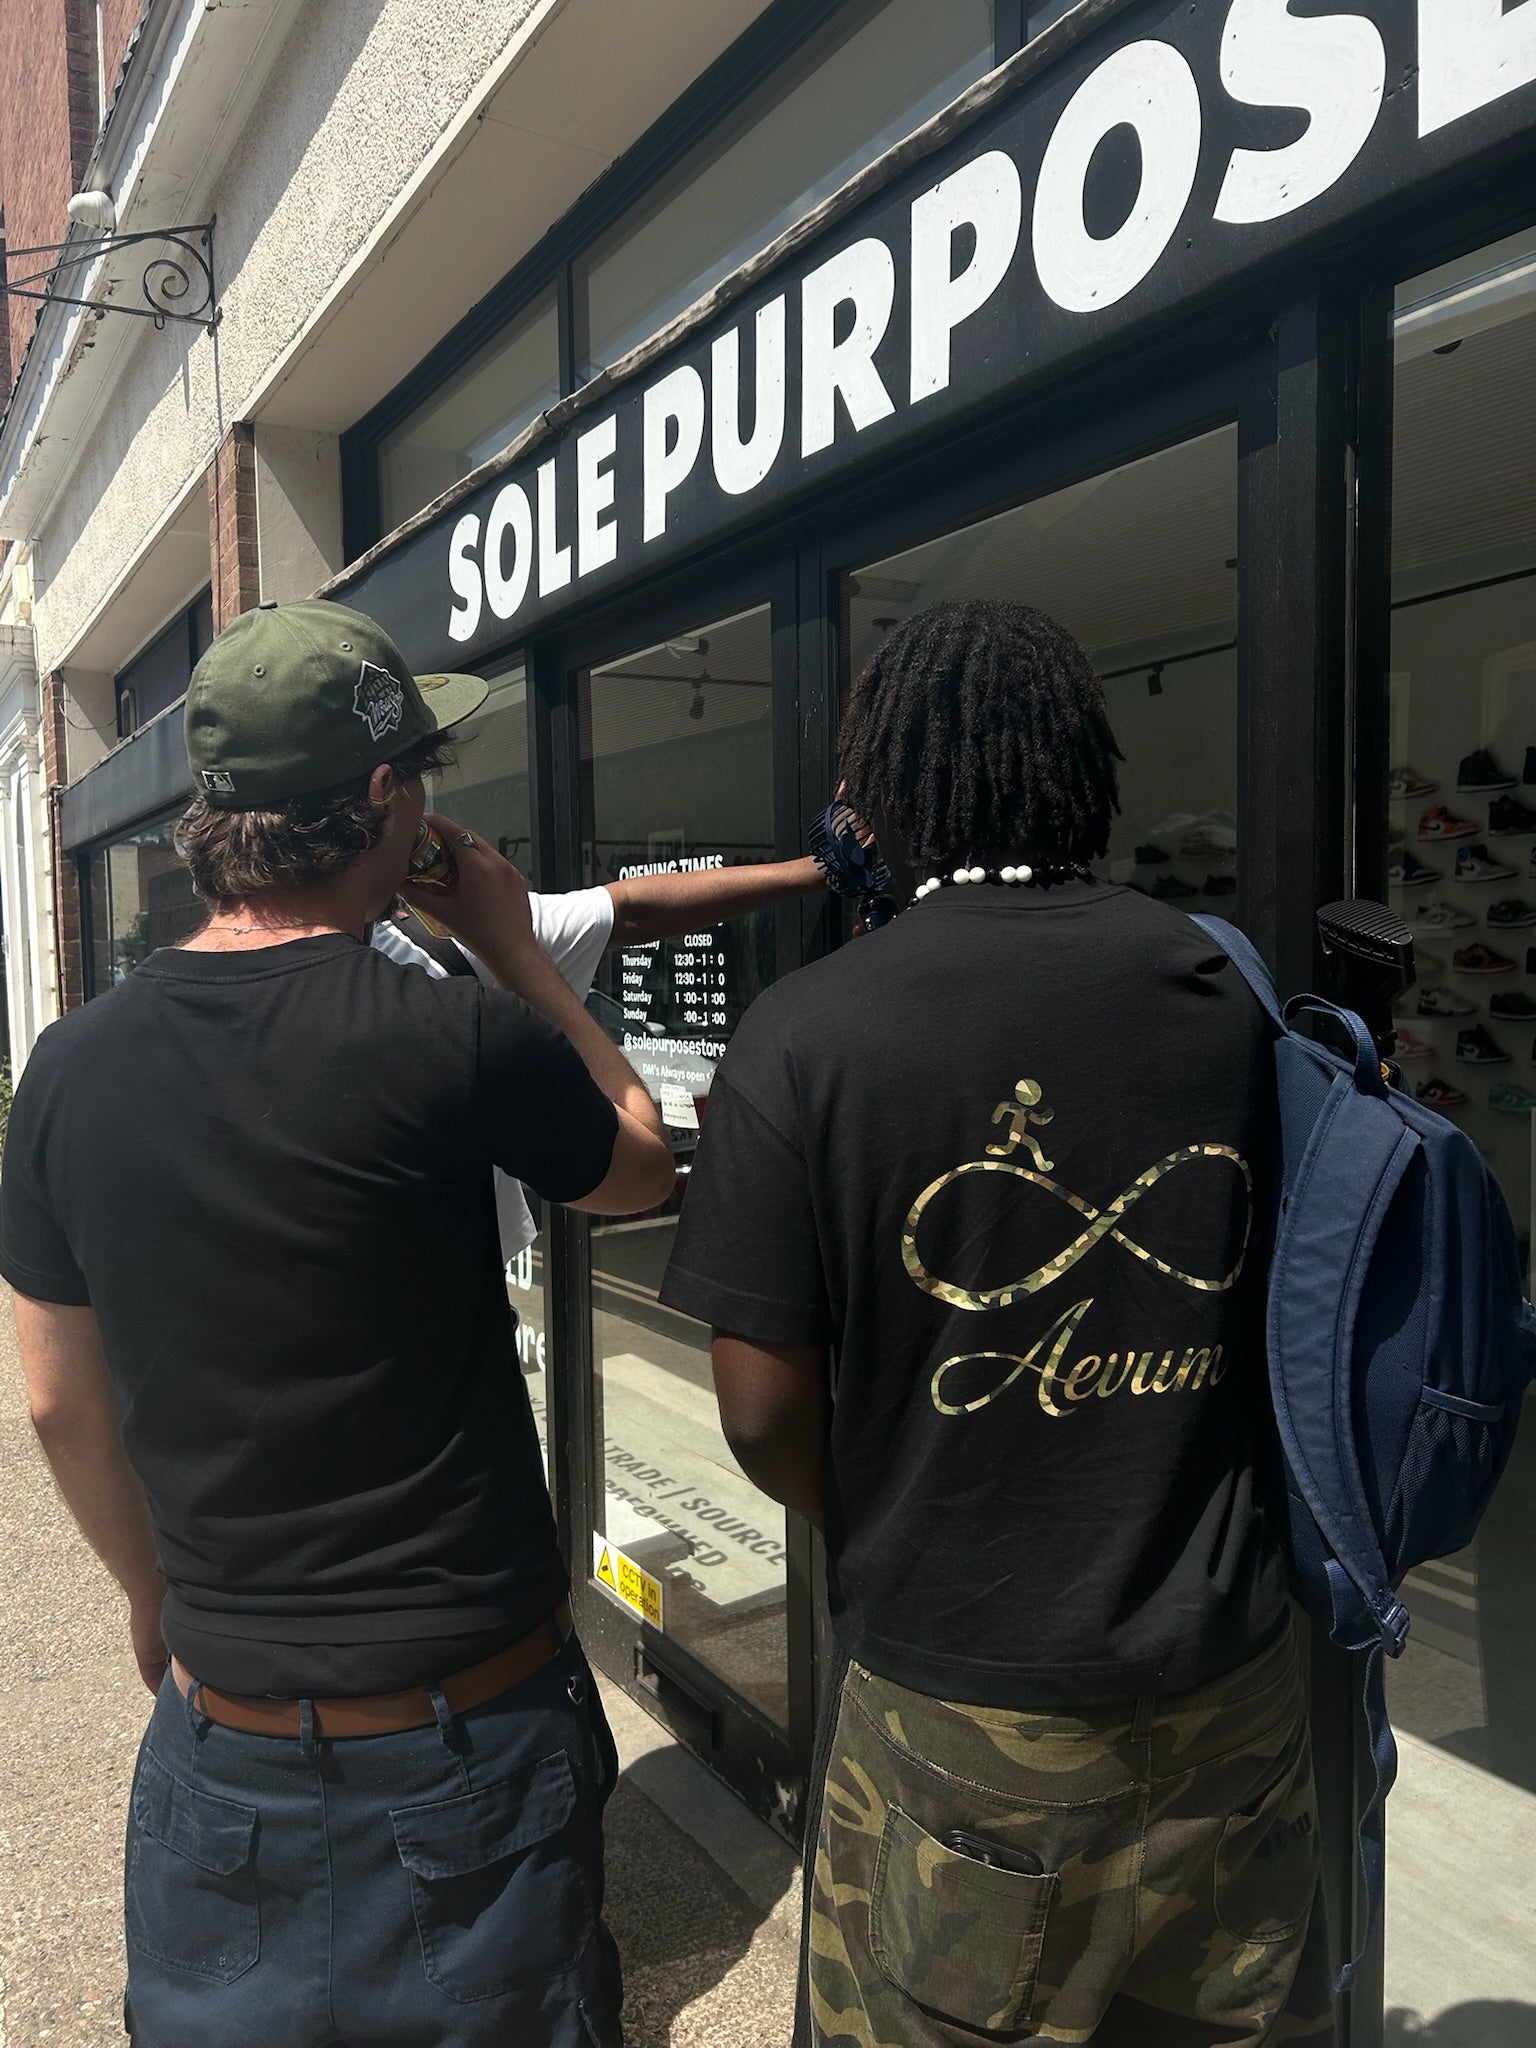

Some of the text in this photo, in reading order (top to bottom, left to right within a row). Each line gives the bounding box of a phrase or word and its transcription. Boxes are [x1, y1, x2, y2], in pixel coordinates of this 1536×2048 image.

[447, 413, 618, 642] SOLE
[684, 934, 713, 947] CLOSED
[622, 954, 652, 969] Thursday
[622, 972, 643, 987] Friday
[623, 990, 652, 1005] Saturday
[623, 1008, 647, 1022] Sunday
[624, 1032, 727, 1058] @solepurposestore
[642, 1063, 660, 1077] DM's
[660, 1065, 685, 1083] Always
[686, 1071, 705, 1083] open
[930, 1297, 1229, 1417] Aevum
[622, 1564, 646, 1592] CCTV
[648, 1583, 657, 1601] in
[620, 1581, 661, 1621] operation
